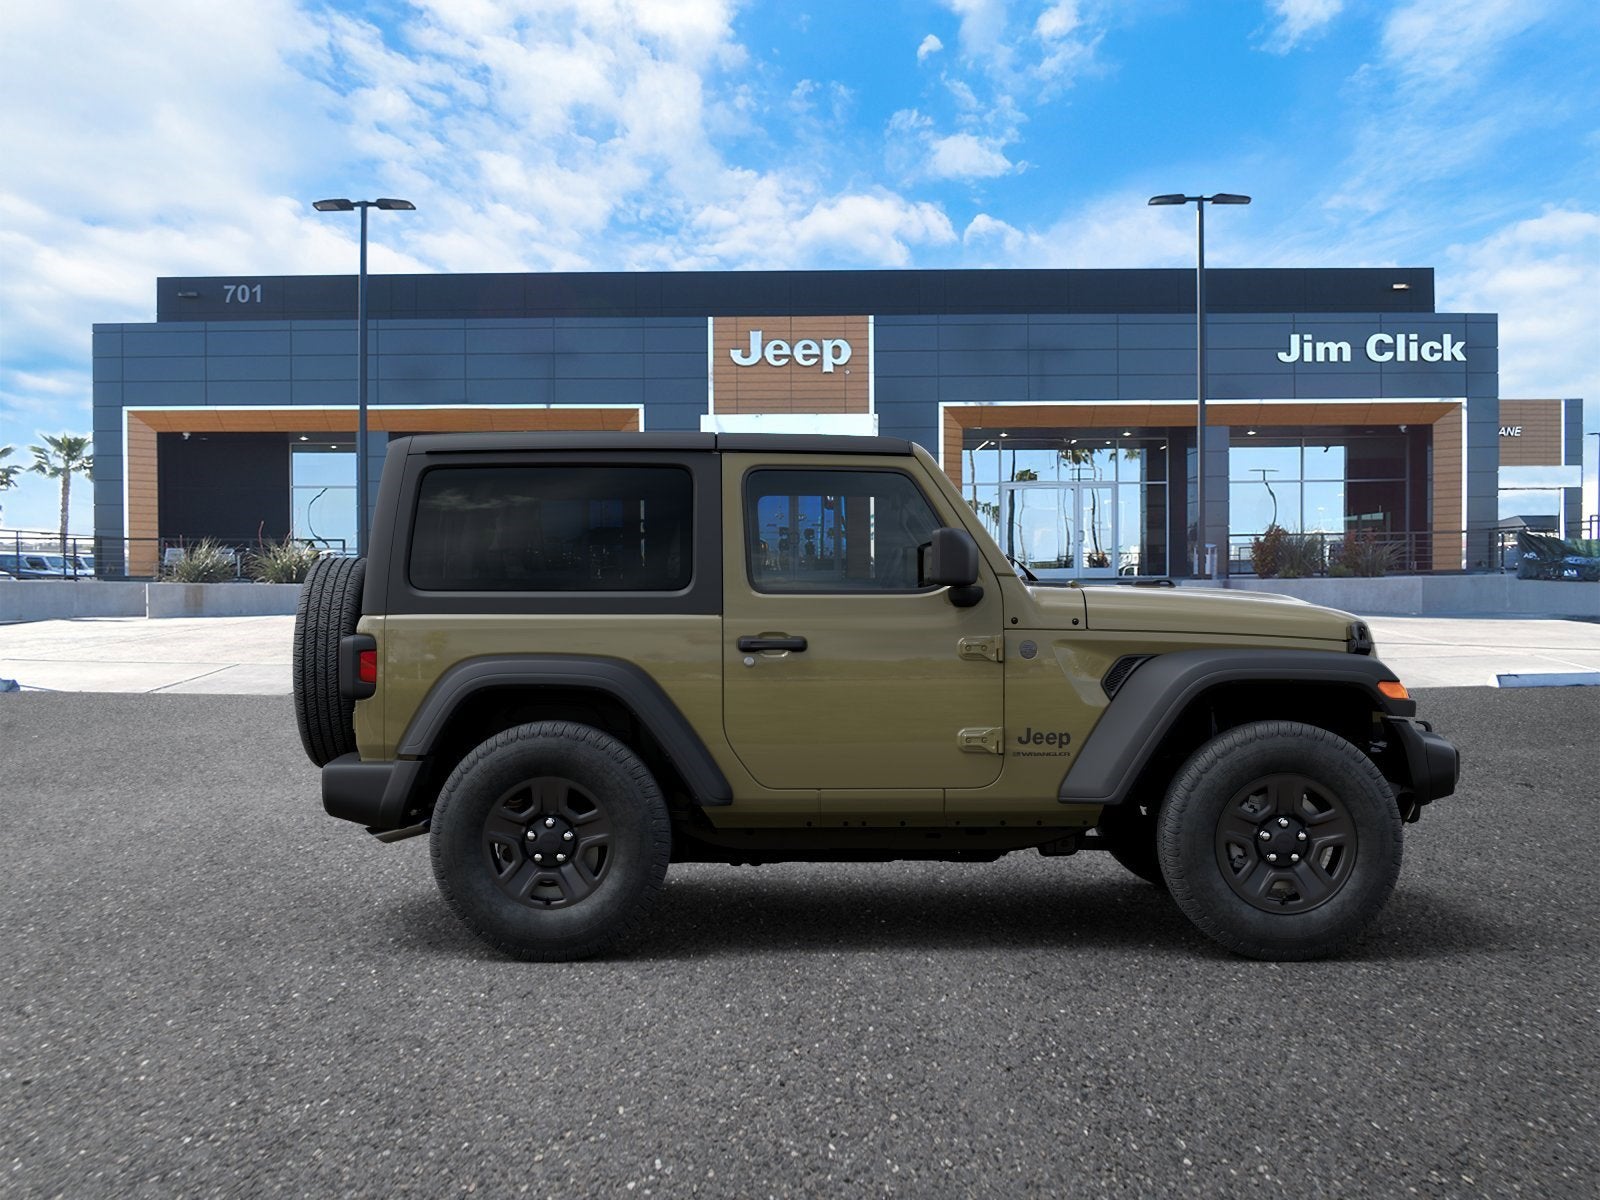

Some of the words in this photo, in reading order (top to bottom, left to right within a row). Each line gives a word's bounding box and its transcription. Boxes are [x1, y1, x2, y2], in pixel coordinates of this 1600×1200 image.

[223, 283, 262, 304] 701
[729, 329, 853, 374] Jeep
[1276, 333, 1352, 364] Jim
[1365, 332, 1468, 363] Click
[1017, 727, 1072, 749] Jeep
